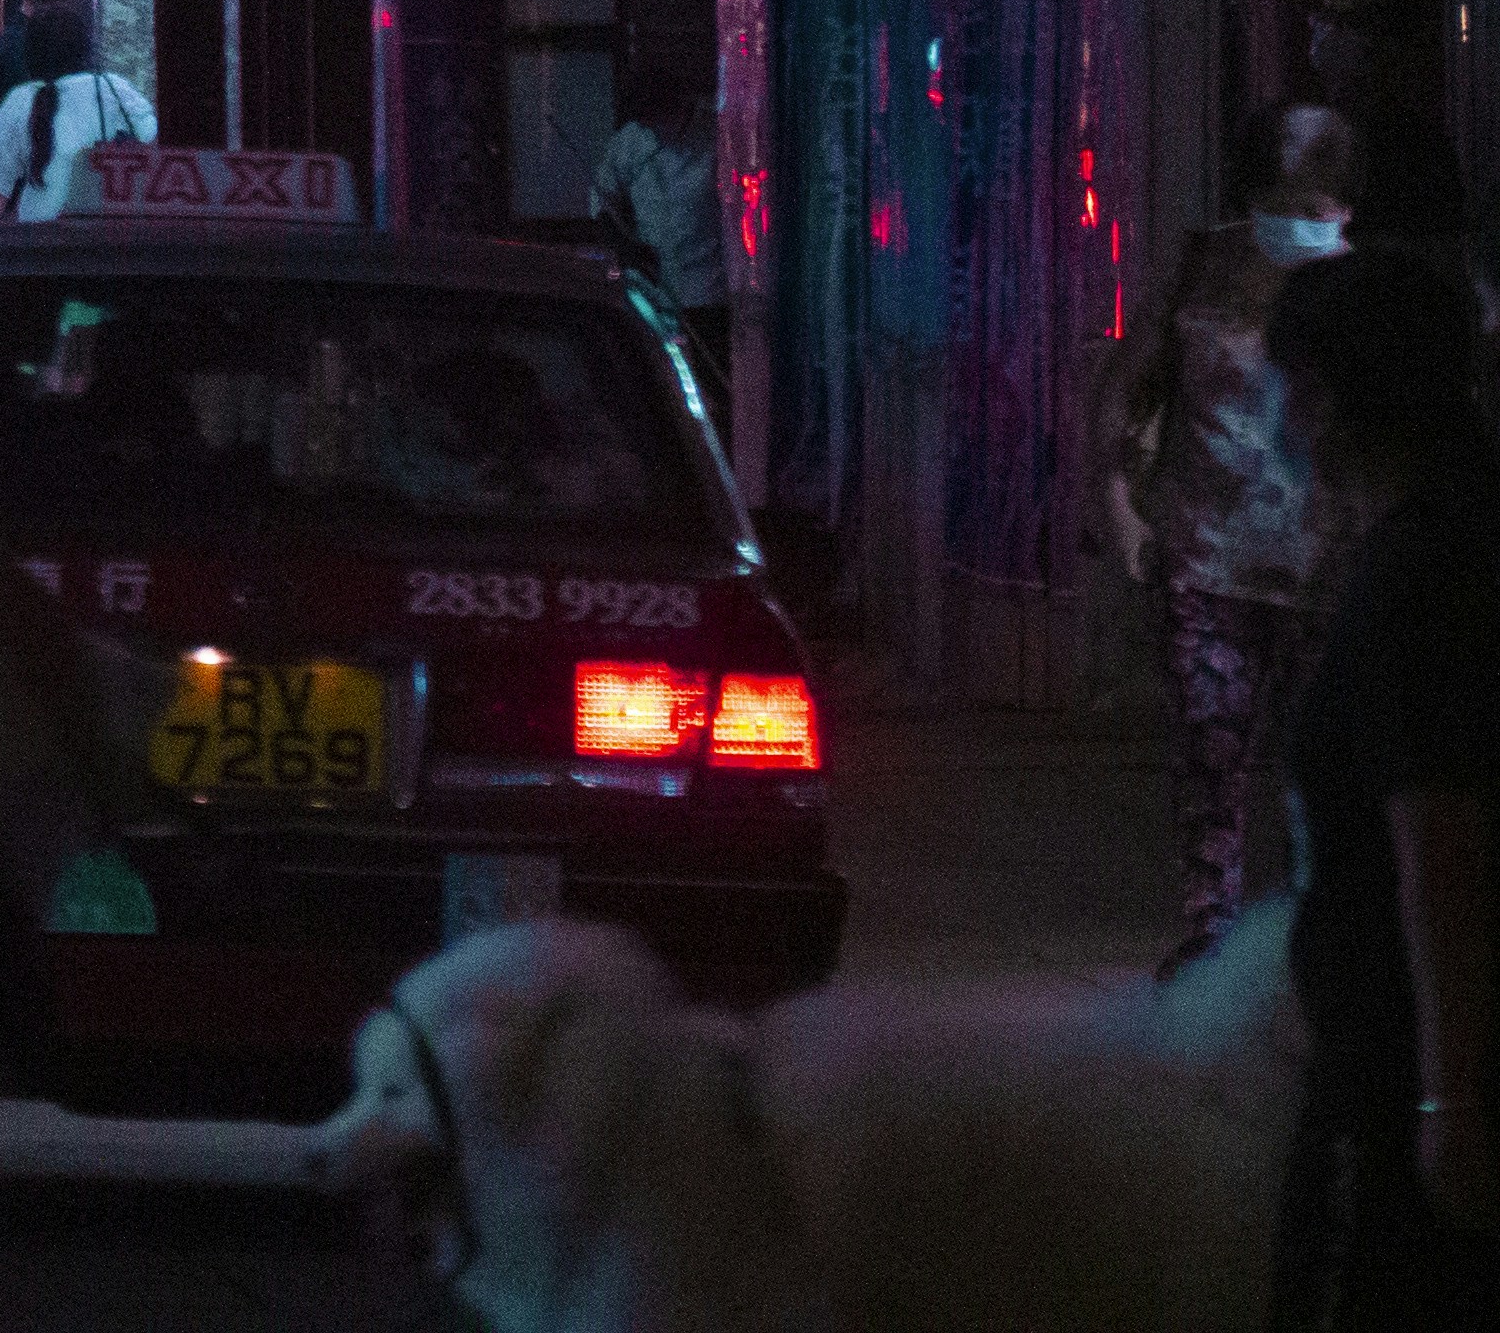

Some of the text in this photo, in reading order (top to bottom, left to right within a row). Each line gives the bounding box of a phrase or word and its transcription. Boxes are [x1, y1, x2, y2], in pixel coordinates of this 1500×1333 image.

[100, 151, 334, 209] TAXI
[406, 571, 699, 628] 2833 9928
[166, 727, 368, 787] 7269
